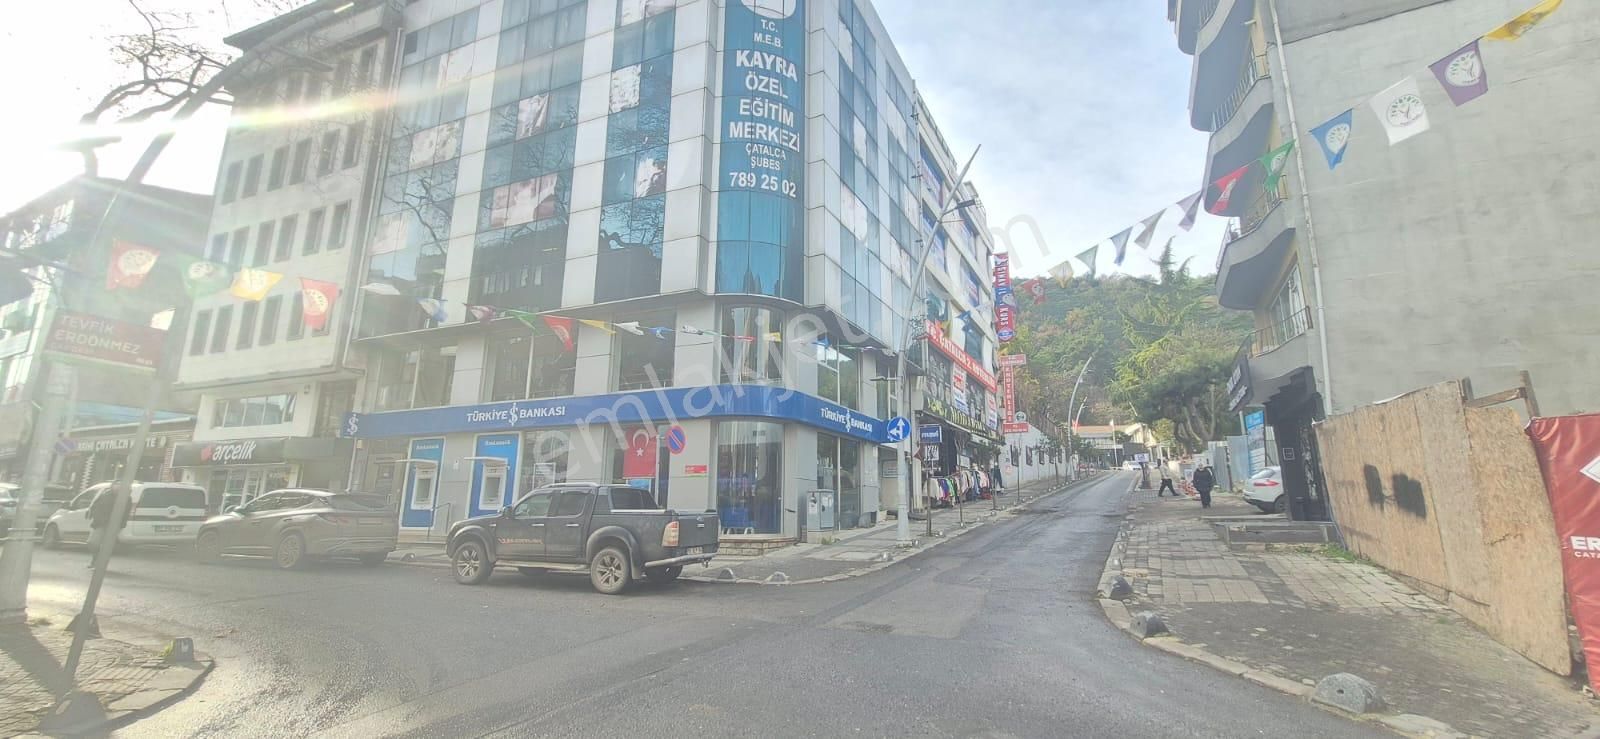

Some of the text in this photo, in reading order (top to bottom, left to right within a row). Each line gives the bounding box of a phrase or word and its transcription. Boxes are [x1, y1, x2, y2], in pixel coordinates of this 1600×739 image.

[760, 19, 779, 33] T.C.
[753, 32, 784, 49] M.E.B.
[736, 49, 798, 82] KAYRA
[745, 71, 789, 99] ÖZEL
[739, 97, 794, 128] EĞİTİM
[729, 121, 800, 152] MERKEZİ
[745, 142, 787, 161] ÇATALCA
[729, 172, 797, 198] 789 25 02
[466, 409, 508, 423] TÜRKİYE
[519, 405, 566, 418] BANKASI
[820, 407, 846, 424] TÜRKİYE
[212, 440, 257, 463] arçelik
